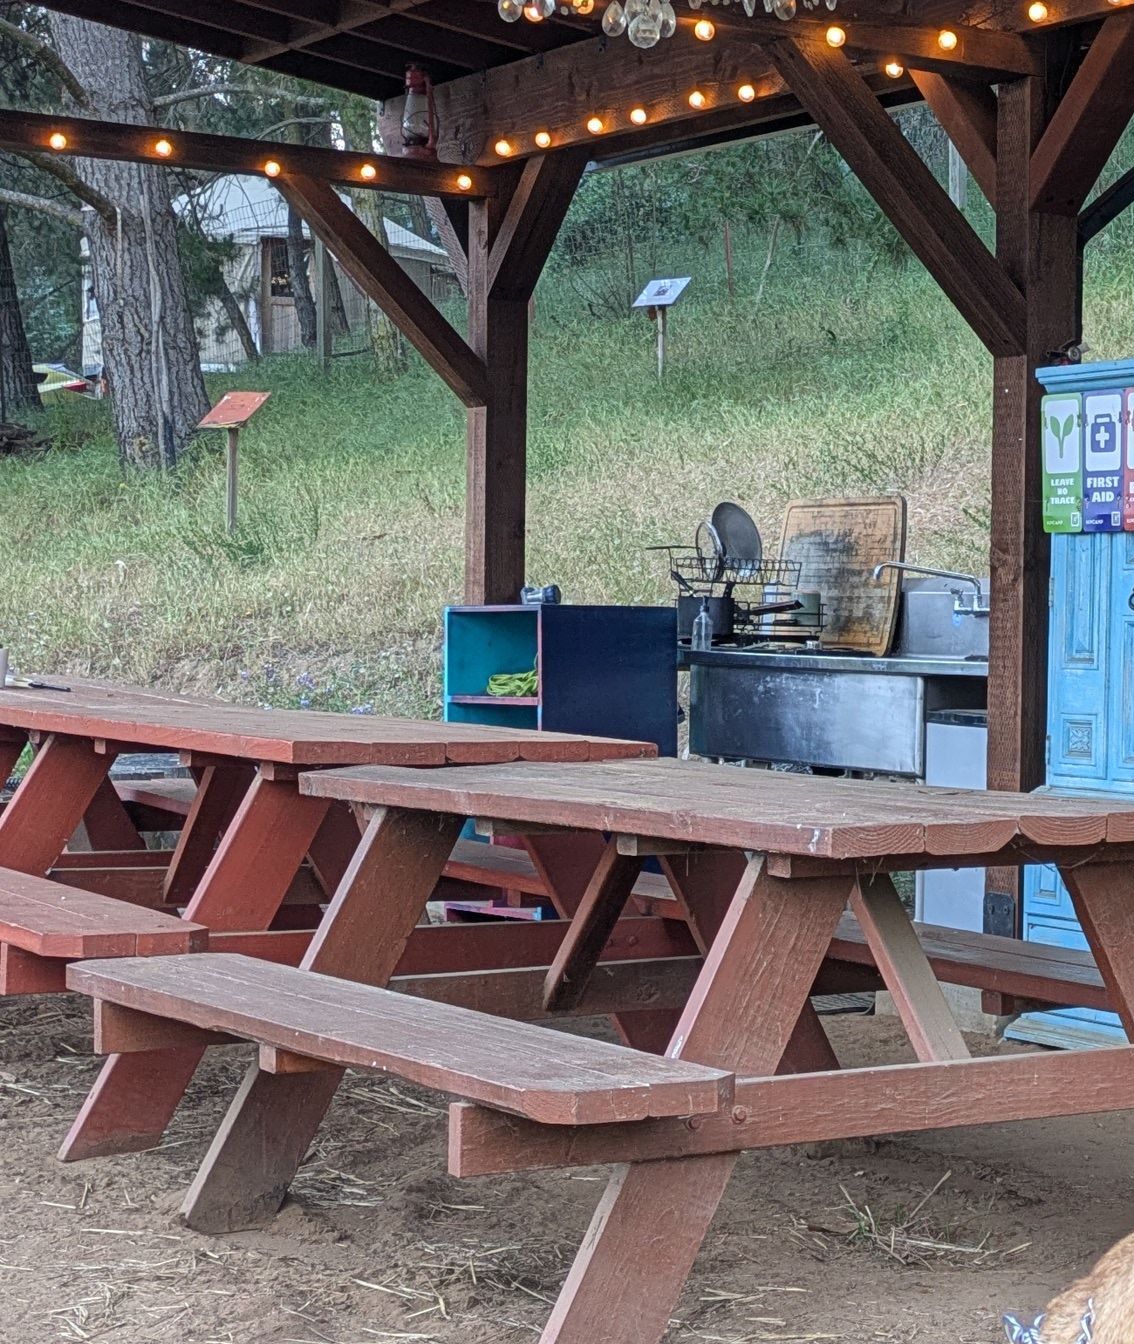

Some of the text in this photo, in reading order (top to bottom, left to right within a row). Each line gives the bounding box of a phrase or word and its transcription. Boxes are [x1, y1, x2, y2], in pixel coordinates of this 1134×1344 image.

[1050, 478, 1074, 486] LEAVE
[1086, 477, 1120, 489] FIRST
[1050, 496, 1075, 505] TRACE
[1091, 491, 1115, 503] AID
